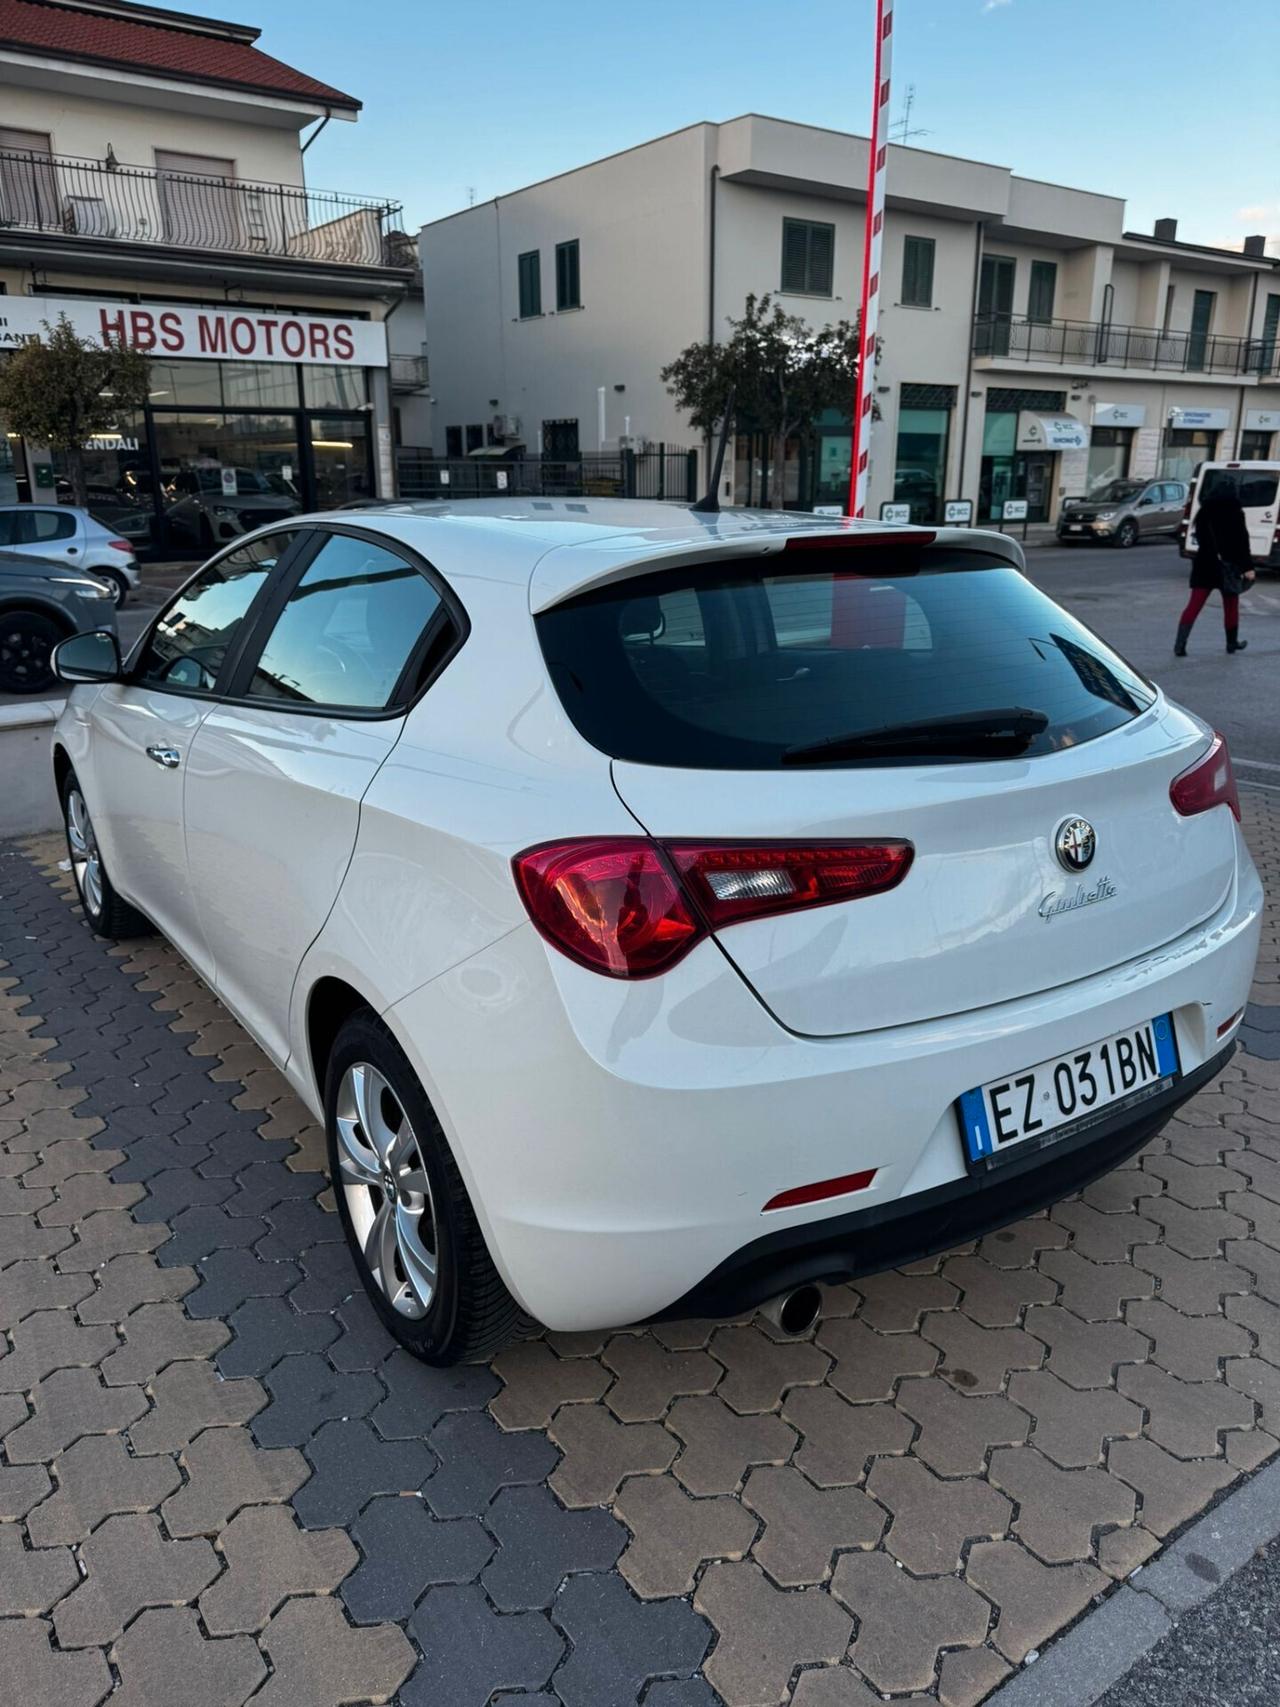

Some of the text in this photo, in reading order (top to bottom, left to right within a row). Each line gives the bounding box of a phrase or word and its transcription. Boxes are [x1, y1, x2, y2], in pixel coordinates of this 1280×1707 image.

[99, 309, 355, 360] HBS MOTORS
[989, 1074, 1042, 1143] EZ
[1054, 1027, 1157, 1116] 031BN
